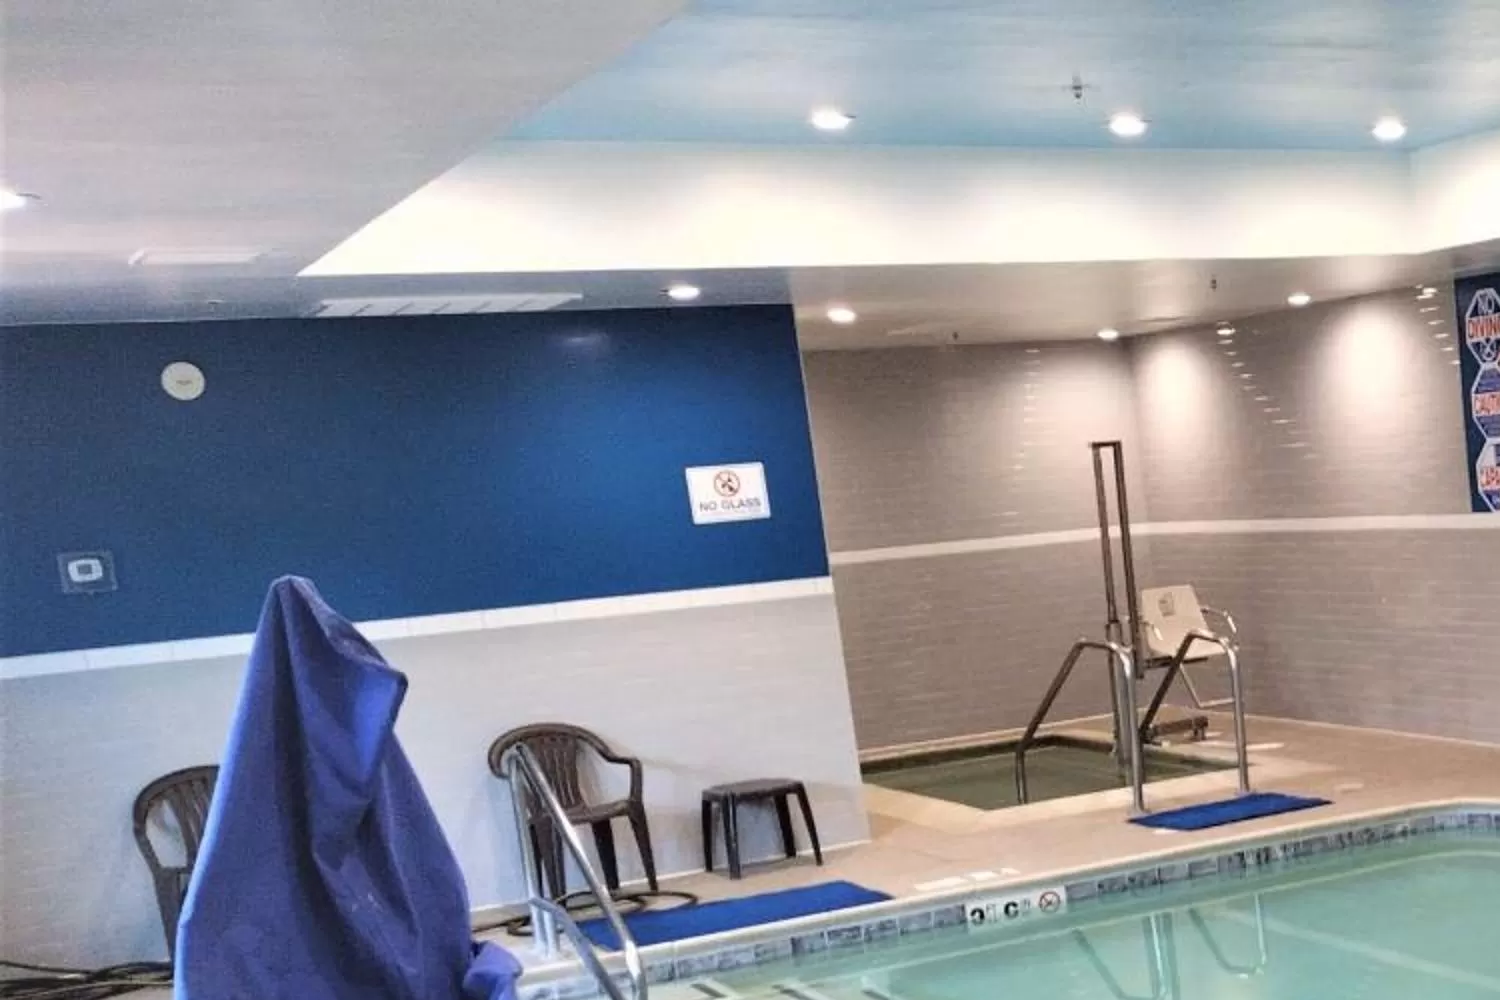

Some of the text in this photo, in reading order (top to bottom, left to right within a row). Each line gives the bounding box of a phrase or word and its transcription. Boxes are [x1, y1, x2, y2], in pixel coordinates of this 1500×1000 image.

[1477, 292, 1495, 315] NO
[700, 497, 761, 512] NO GLASS
